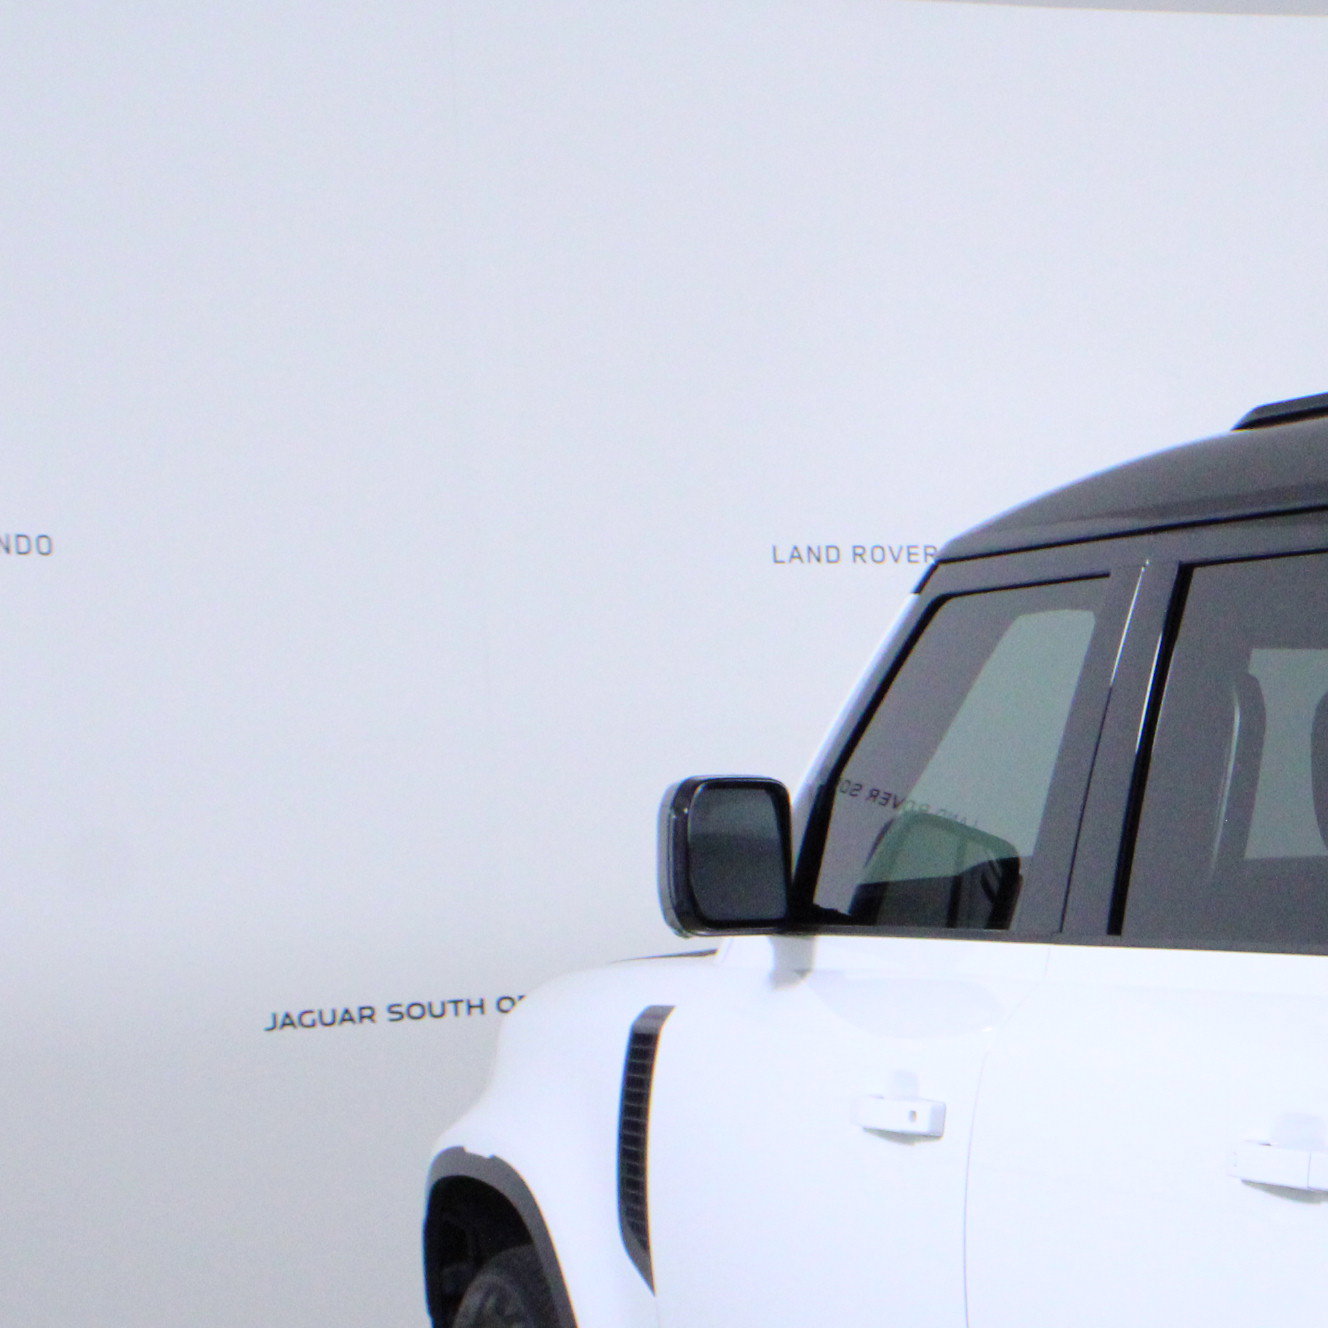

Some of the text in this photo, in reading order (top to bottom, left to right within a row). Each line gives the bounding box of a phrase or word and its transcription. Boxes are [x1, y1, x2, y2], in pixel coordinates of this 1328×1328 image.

[771, 544, 938, 565] LAND ROVER
[263, 1005, 377, 1032] JAGUAR
[386, 998, 486, 1022] SOUTH
